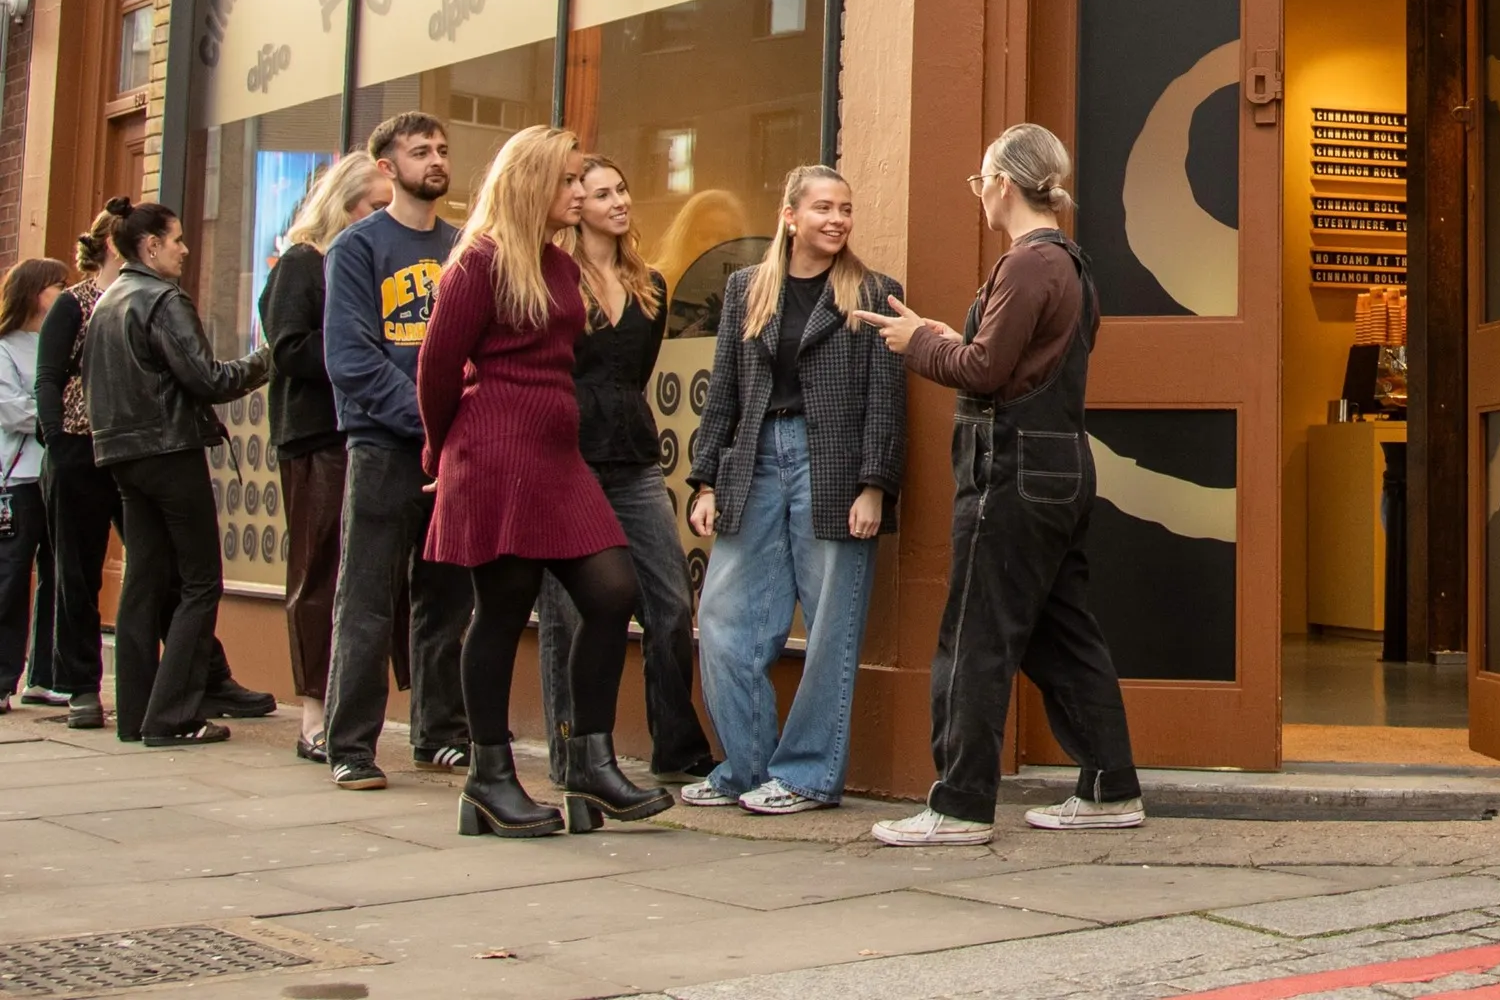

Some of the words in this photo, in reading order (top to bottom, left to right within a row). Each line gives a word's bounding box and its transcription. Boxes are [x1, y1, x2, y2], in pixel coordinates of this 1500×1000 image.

[1316, 112, 1369, 124] CINNAMON
[1373, 115, 1399, 126] ROLL
[1316, 129, 1369, 141] CINNAMON
[1373, 132, 1399, 143] ROLL
[1316, 146, 1369, 159] CINNAMON
[1373, 150, 1399, 161] ROLL
[1316, 164, 1369, 176] CINNAMON
[1373, 168, 1399, 178] ROLL
[1316, 200, 1369, 211] CINNAMON
[1373, 203, 1399, 213] ROLL
[1316, 253, 1329, 263] NO
[1336, 254, 1369, 265] FOAMO
[1376, 256, 1388, 266] AT
[1316, 271, 1368, 283] CINNAMON
